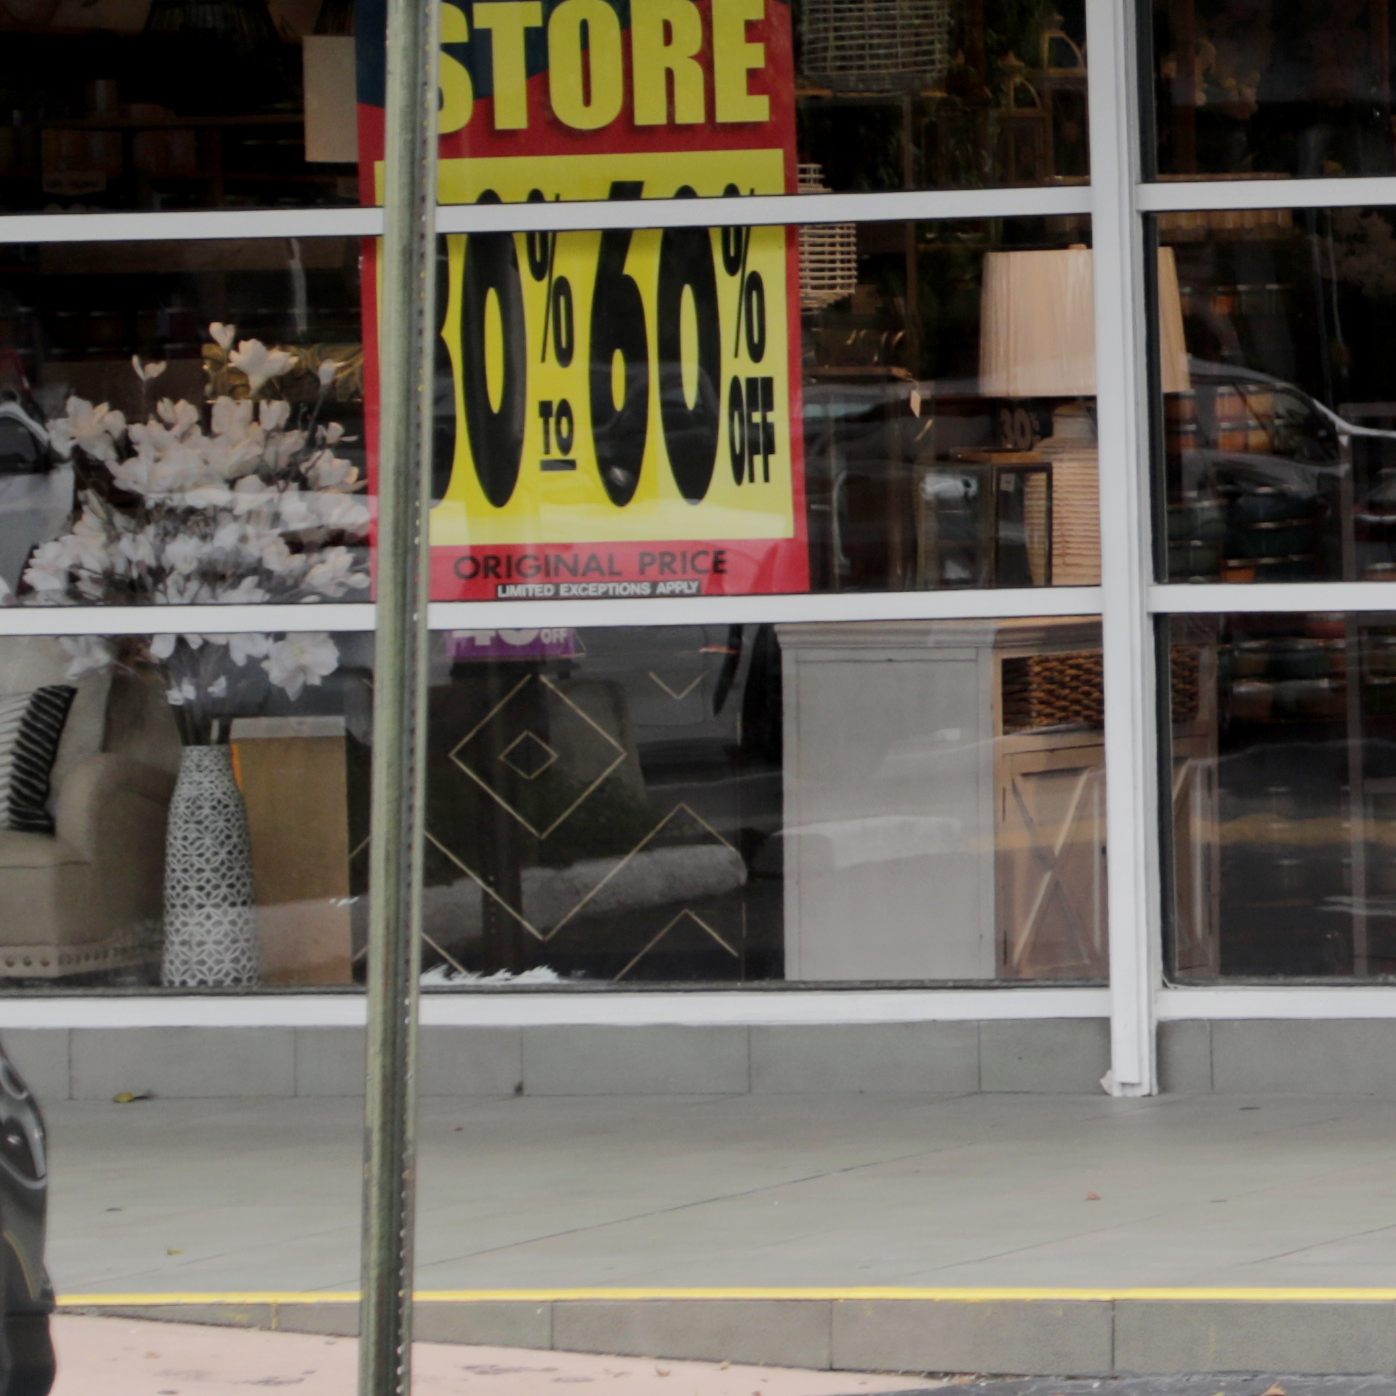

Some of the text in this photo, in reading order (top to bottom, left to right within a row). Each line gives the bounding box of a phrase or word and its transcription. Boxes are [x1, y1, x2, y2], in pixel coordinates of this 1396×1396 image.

[538, 398, 576, 454] TO
[729, 375, 776, 487] OFF
[453, 549, 728, 581] ORIGINAL PRICE
[497, 580, 700, 599] LIMITED EXCEPTIONS APPLY
